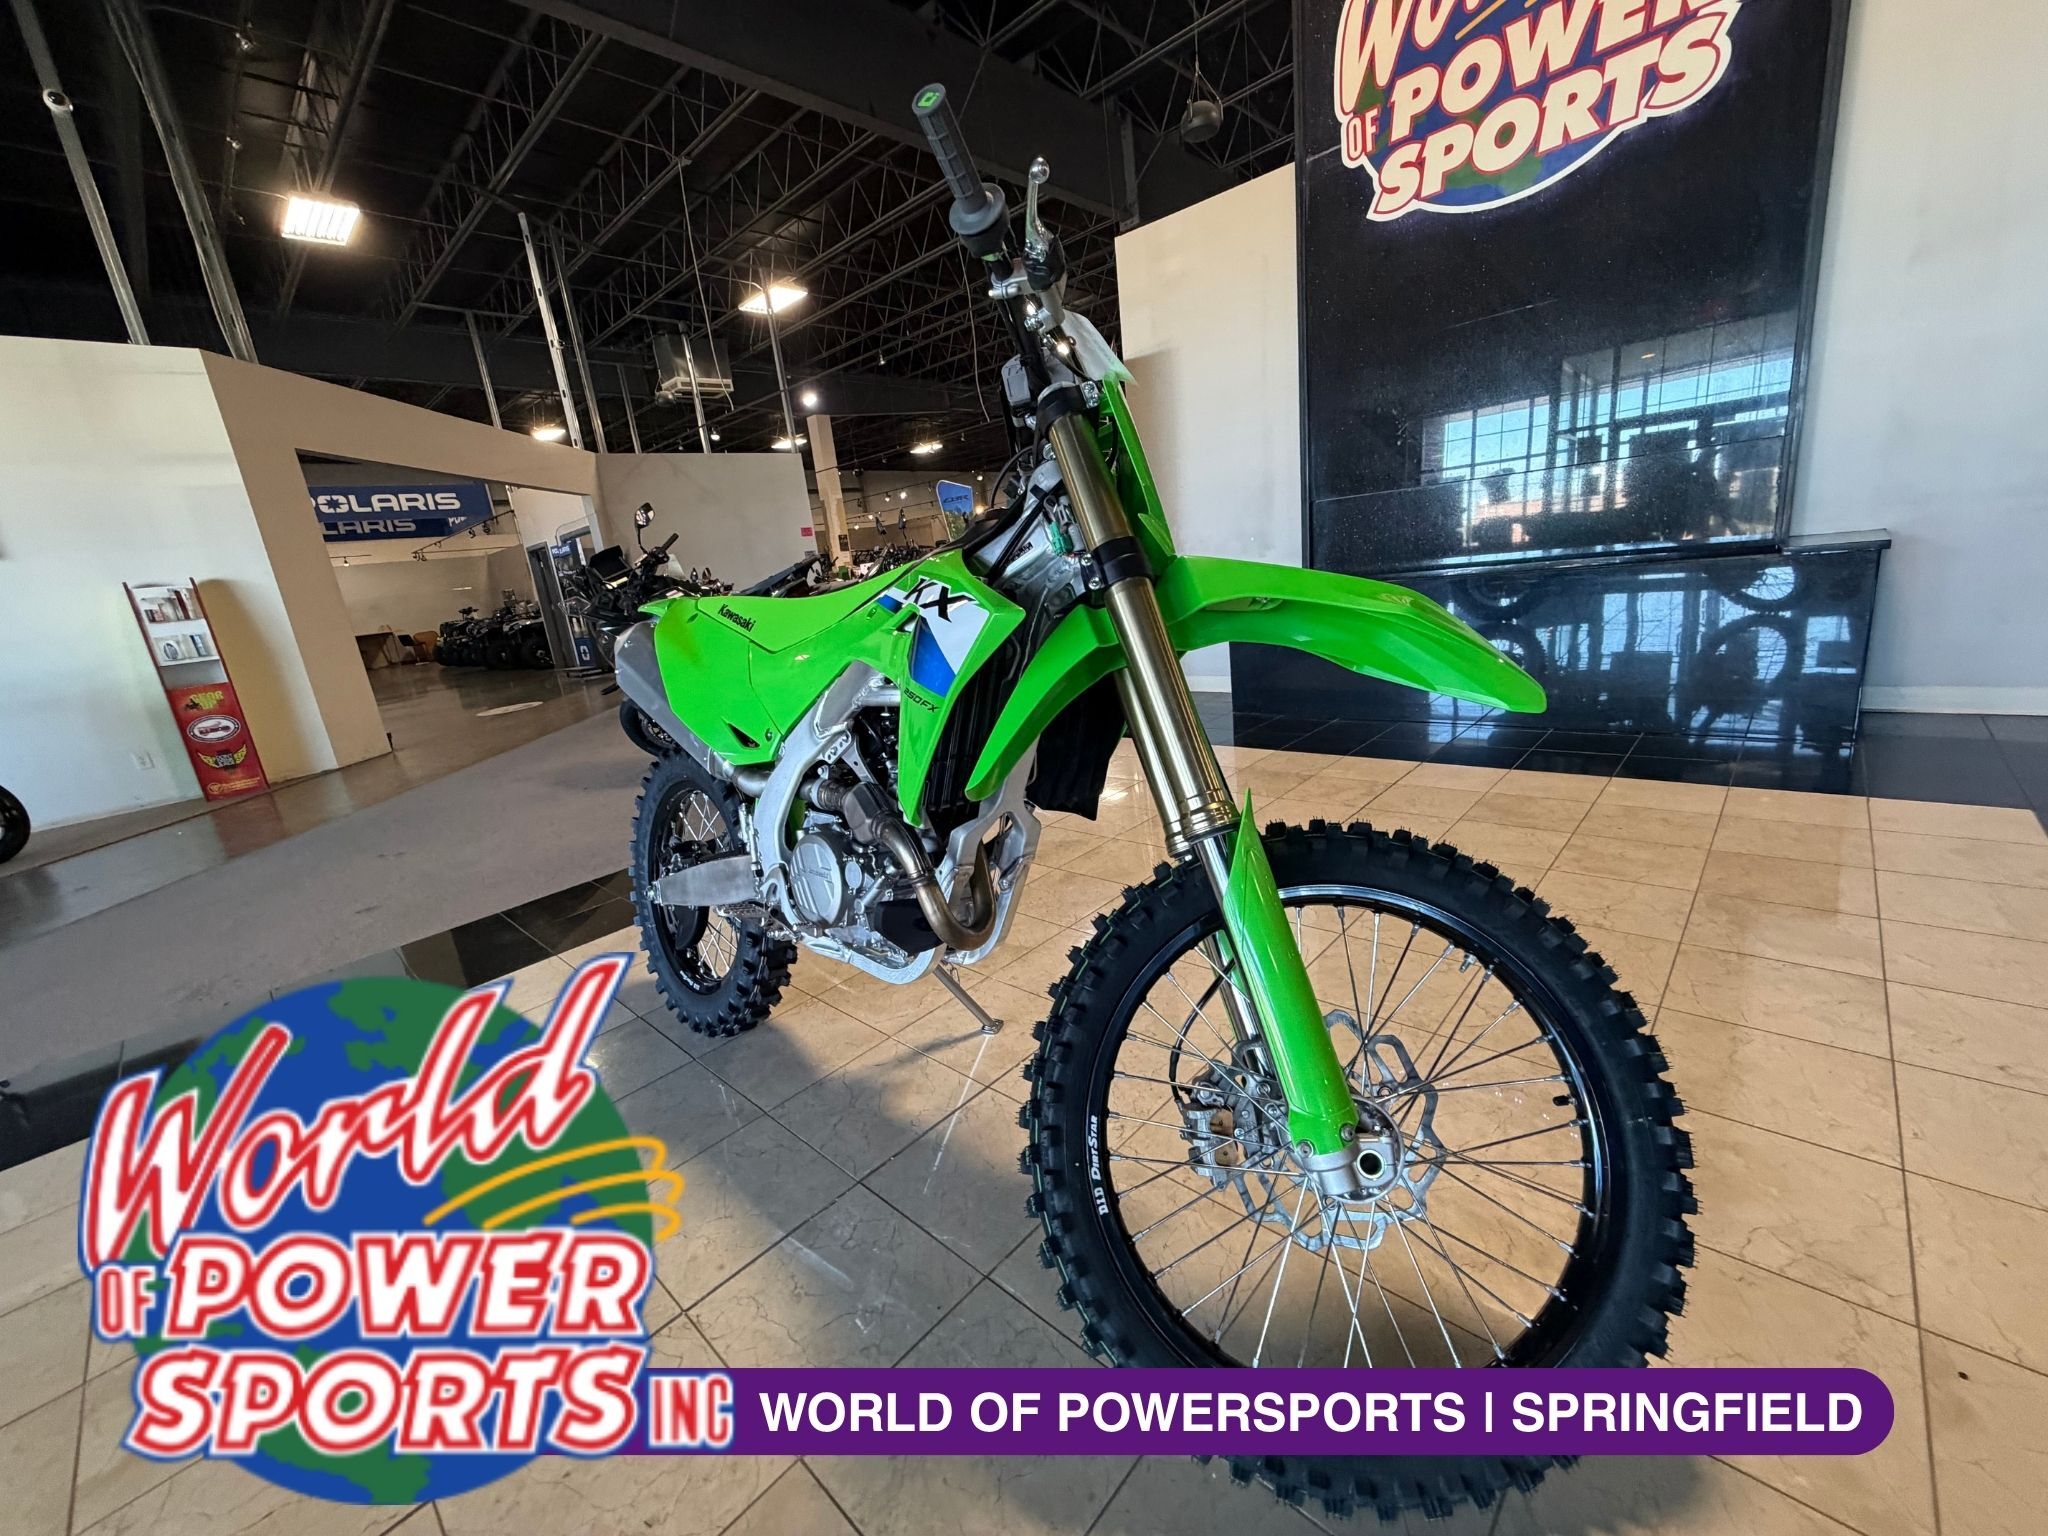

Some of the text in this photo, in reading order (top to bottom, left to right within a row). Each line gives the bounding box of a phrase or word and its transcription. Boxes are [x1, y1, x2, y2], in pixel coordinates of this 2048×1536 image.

[1372, 11, 1730, 215] SPORTS
[1346, 103, 1380, 162] OF
[310, 492, 462, 514] OLARIS
[321, 518, 418, 535] LARIS
[902, 577, 977, 624] KX
[717, 603, 757, 633] Kawasaki
[903, 687, 942, 713] 250FX
